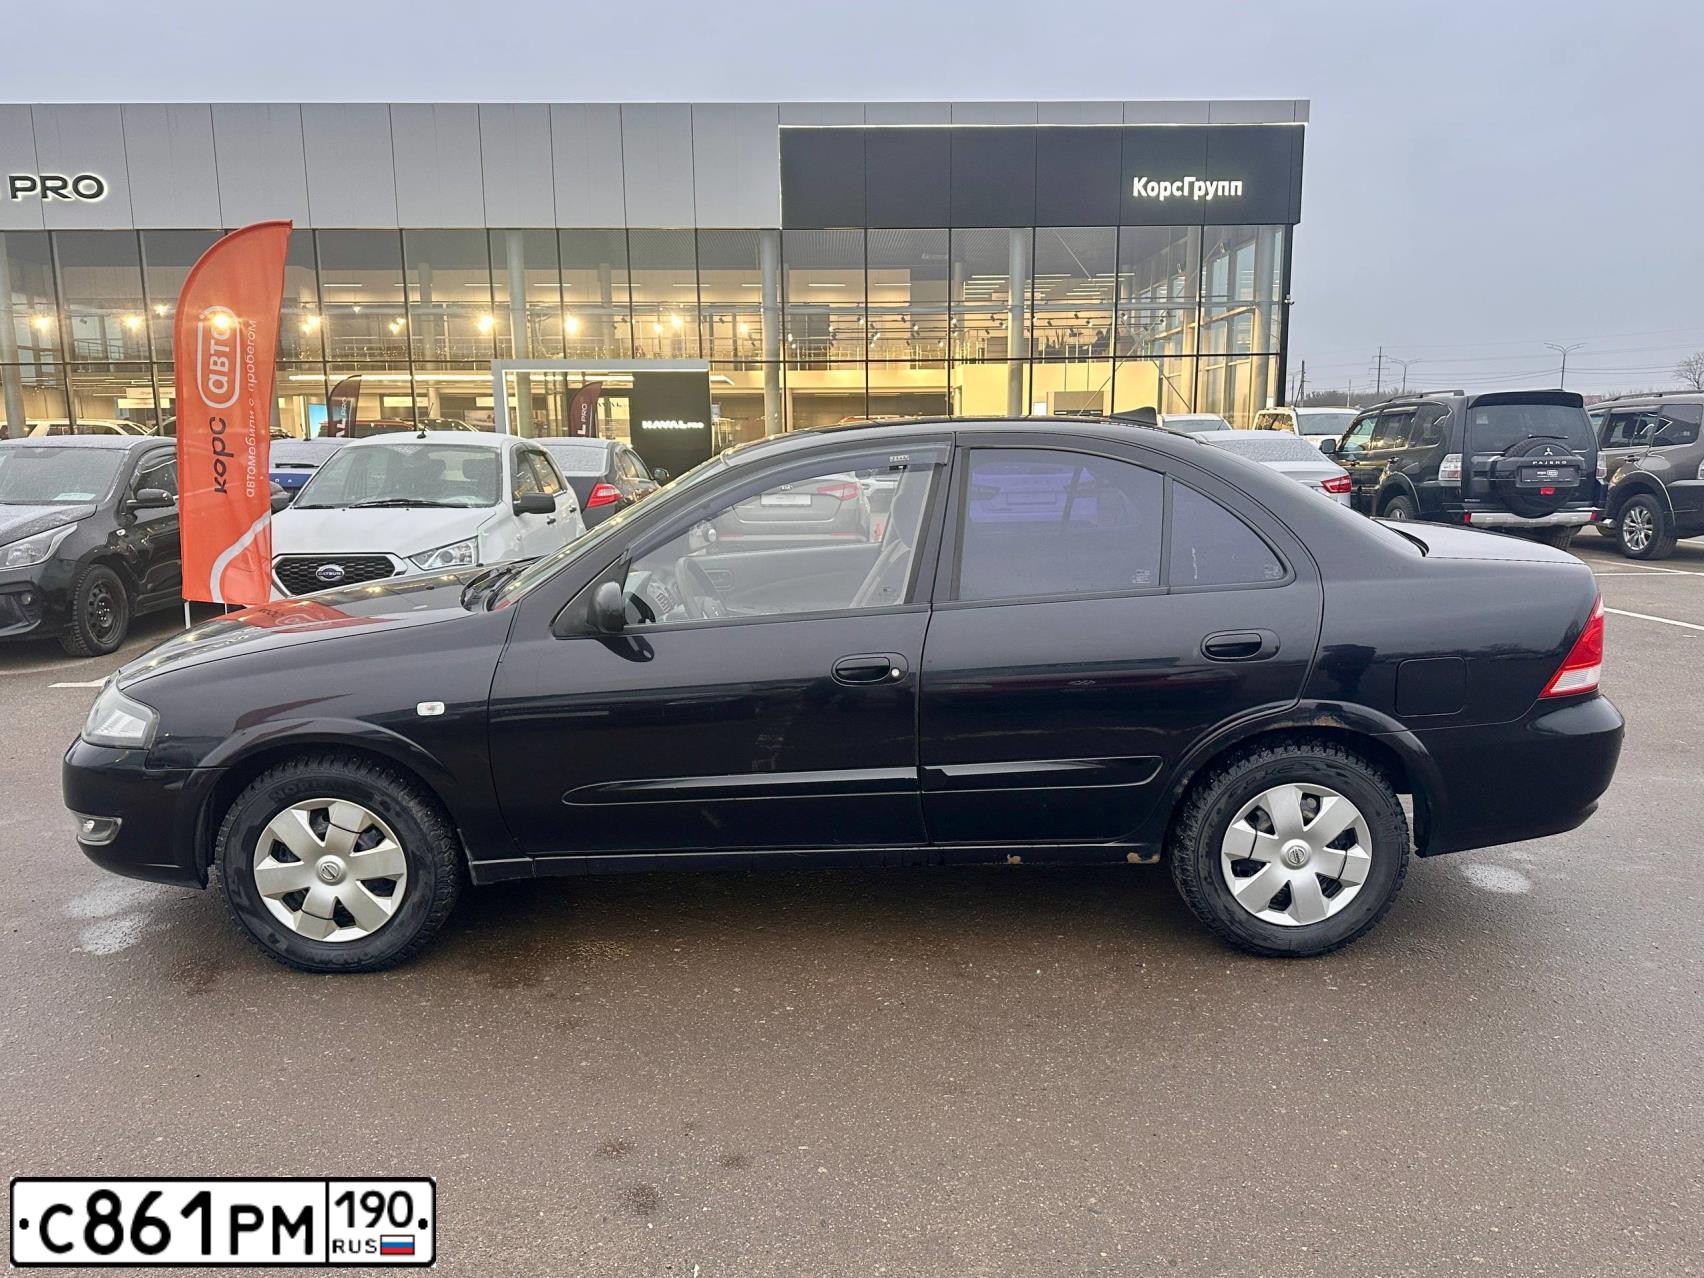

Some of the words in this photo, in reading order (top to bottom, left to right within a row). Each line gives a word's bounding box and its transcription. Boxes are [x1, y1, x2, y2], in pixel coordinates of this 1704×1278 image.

[8, 174, 105, 200] PRO
[1132, 176, 1243, 201] КорсГрупп
[207, 316, 232, 394] авто
[244, 319, 258, 392] пробегом
[248, 398, 255, 407] с
[580, 403, 588, 422] PRO
[208, 416, 235, 495] корс
[245, 410, 257, 498] автомобили
